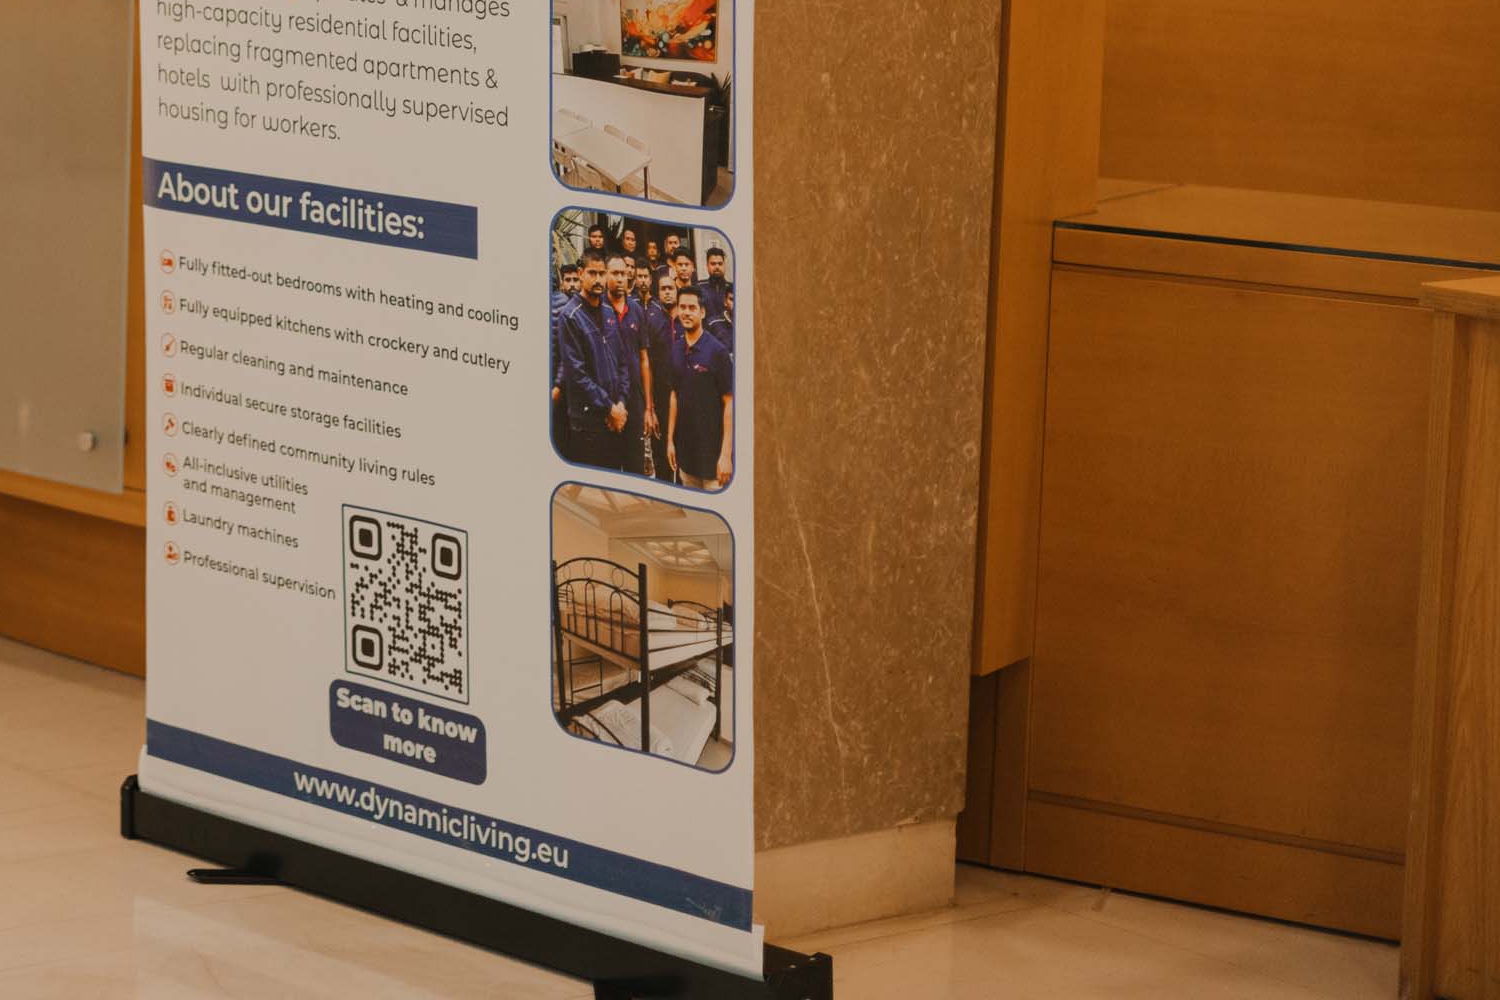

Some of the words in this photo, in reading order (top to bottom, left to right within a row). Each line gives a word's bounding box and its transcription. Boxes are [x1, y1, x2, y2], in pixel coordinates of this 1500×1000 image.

[157, 33, 241, 62] replacing
[247, 41, 357, 69] fragmented
[363, 56, 480, 87] apartments
[486, 69, 498, 88] &
[289, 12, 387, 41] residential
[392, 21, 477, 54] facilities,
[158, 64, 210, 89] hotels
[221, 73, 260, 96] with
[267, 81, 396, 117] professionally
[403, 97, 509, 127] supervised
[159, 98, 228, 130] housing
[234, 106, 257, 128] for
[263, 116, 340, 141] workers.
[158, 172, 240, 210] About
[246, 189, 292, 218] our
[299, 192, 425, 239] facilities:
[179, 256, 209, 277] Fully
[211, 261, 273, 286] fitted-out
[276, 272, 342, 297] bedrooms
[345, 285, 375, 303] with
[380, 290, 434, 315] heating
[438, 300, 464, 318] and
[468, 307, 520, 331] cooling
[180, 298, 209, 319] Fully
[213, 308, 272, 331] equipped
[276, 317, 331, 339] kitchens
[335, 327, 364, 345] with
[368, 334, 429, 359] crockery
[433, 343, 458, 361] and
[462, 350, 510, 374] cutlery
[180, 340, 228, 364] Regular
[232, 349, 286, 375] cleaning
[289, 361, 314, 379] and
[318, 368, 408, 396] maintenance
[181, 382, 243, 408] Individual
[245, 398, 287, 417] secure
[291, 405, 340, 428] storage
[343, 415, 402, 439] facilities
[182, 421, 224, 444] Clearly
[228, 430, 276, 454] defined
[280, 445, 356, 473] community
[359, 458, 398, 481] living
[402, 467, 436, 487] rules
[183, 456, 257, 485] All-inclusive
[261, 474, 309, 496] utilities
[183, 477, 207, 495] and
[211, 485, 296, 514] management
[182, 509, 234, 535] Laundry
[238, 522, 299, 548] machines
[184, 550, 259, 581] Professional
[261, 571, 336, 601] supervision
[336, 687, 387, 720] Scan
[391, 702, 412, 726] to
[417, 708, 478, 744] know
[383, 733, 437, 764] more
[293, 770, 569, 869] www.dynamicliving.eu
